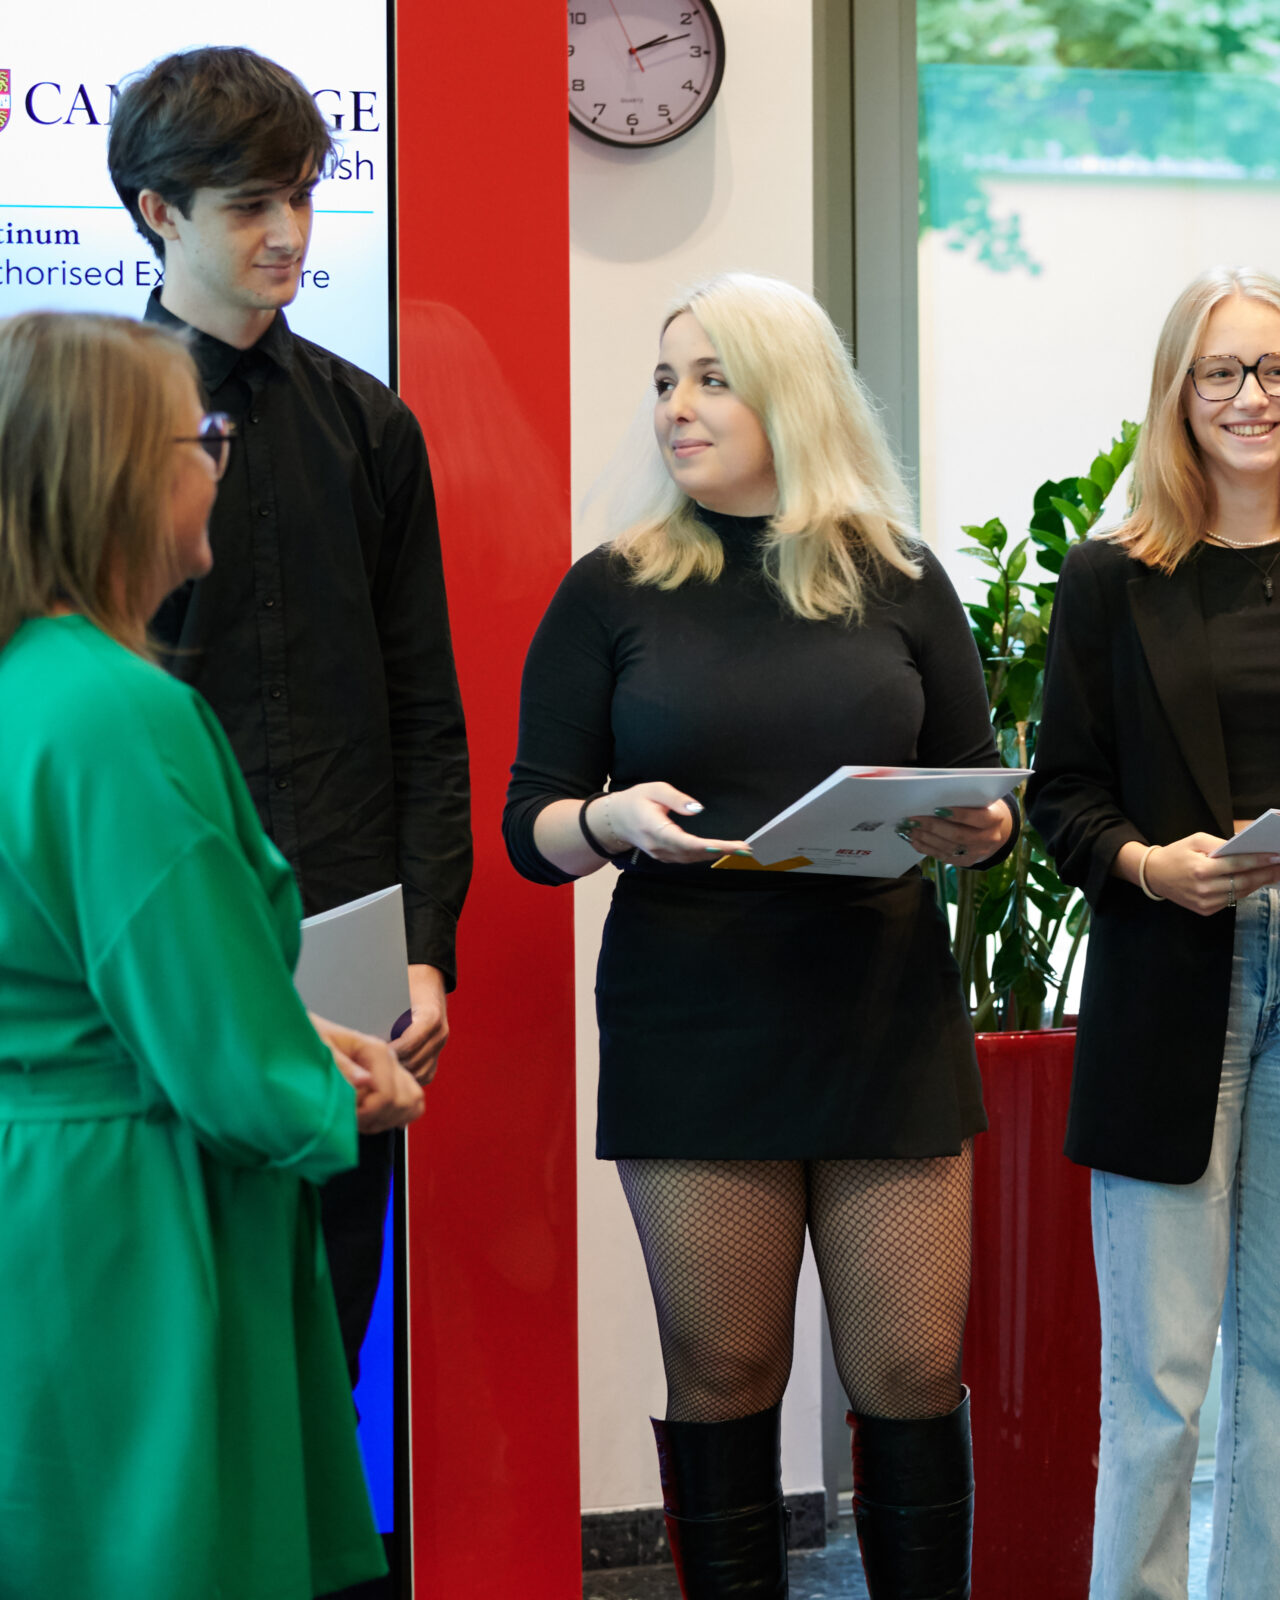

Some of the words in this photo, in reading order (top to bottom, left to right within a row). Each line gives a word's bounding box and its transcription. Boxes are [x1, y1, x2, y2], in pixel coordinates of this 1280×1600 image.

[569, 12, 586, 25] 10
[680, 12, 693, 25] 2
[690, 46, 702, 58] 3
[572, 79, 585, 91] 8
[681, 80, 694, 91] 4
[594, 103, 607, 116] 7
[658, 104, 670, 117] 5
[626, 113, 639, 126] 6
